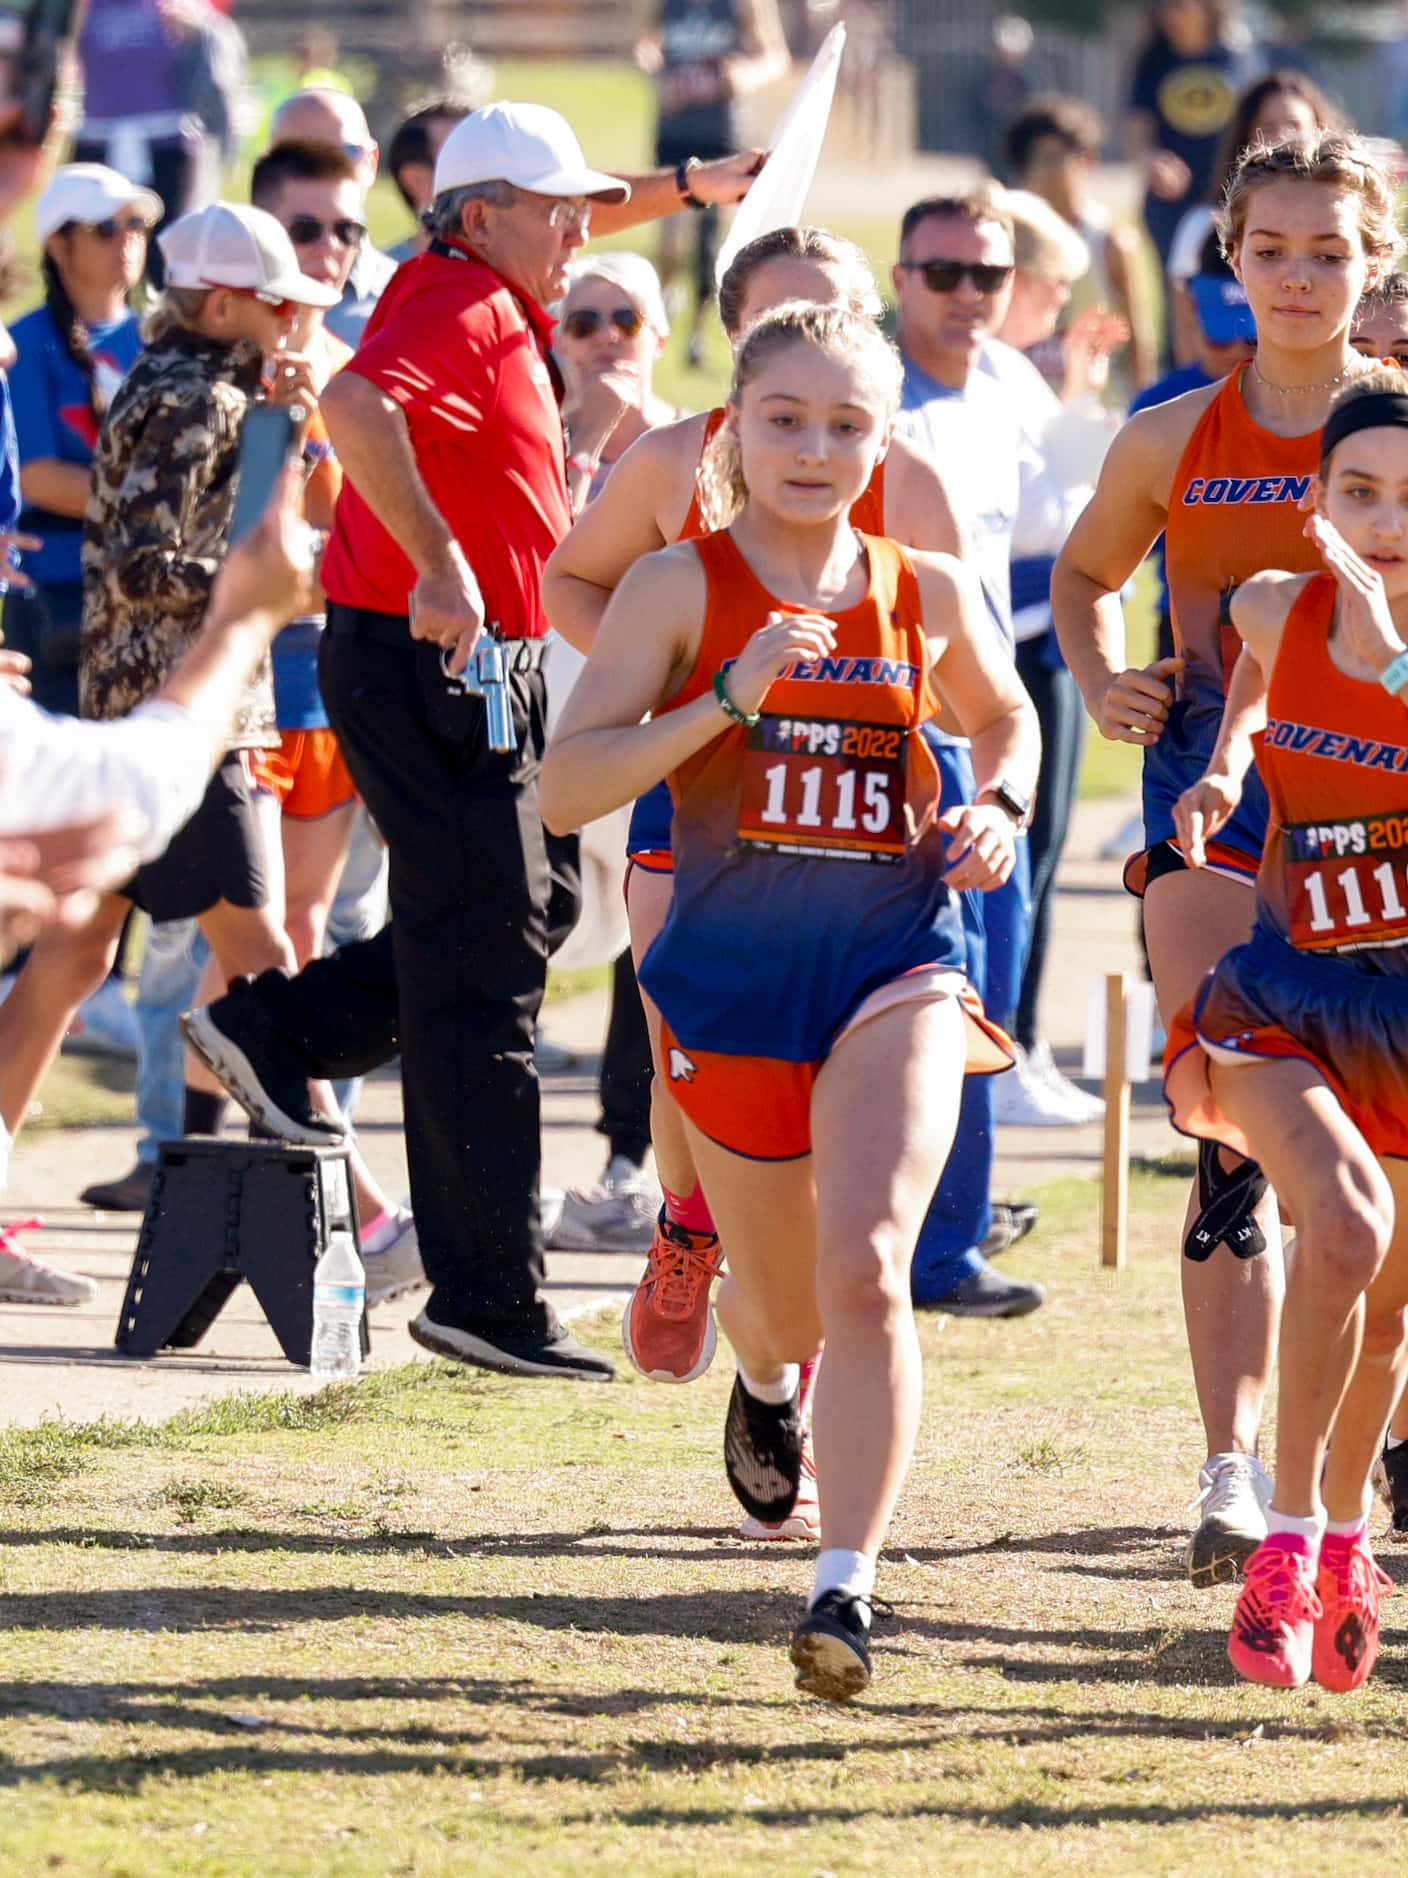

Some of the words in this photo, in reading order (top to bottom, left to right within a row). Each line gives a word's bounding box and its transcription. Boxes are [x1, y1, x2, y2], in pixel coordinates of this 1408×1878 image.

[1183, 474, 1319, 505] COVEN
[719, 656, 921, 688] ENANT
[761, 719, 841, 755] TAPPS
[841, 726, 900, 759] 2022
[760, 763, 891, 834] 1115
[1291, 822, 1366, 858] TAPPS
